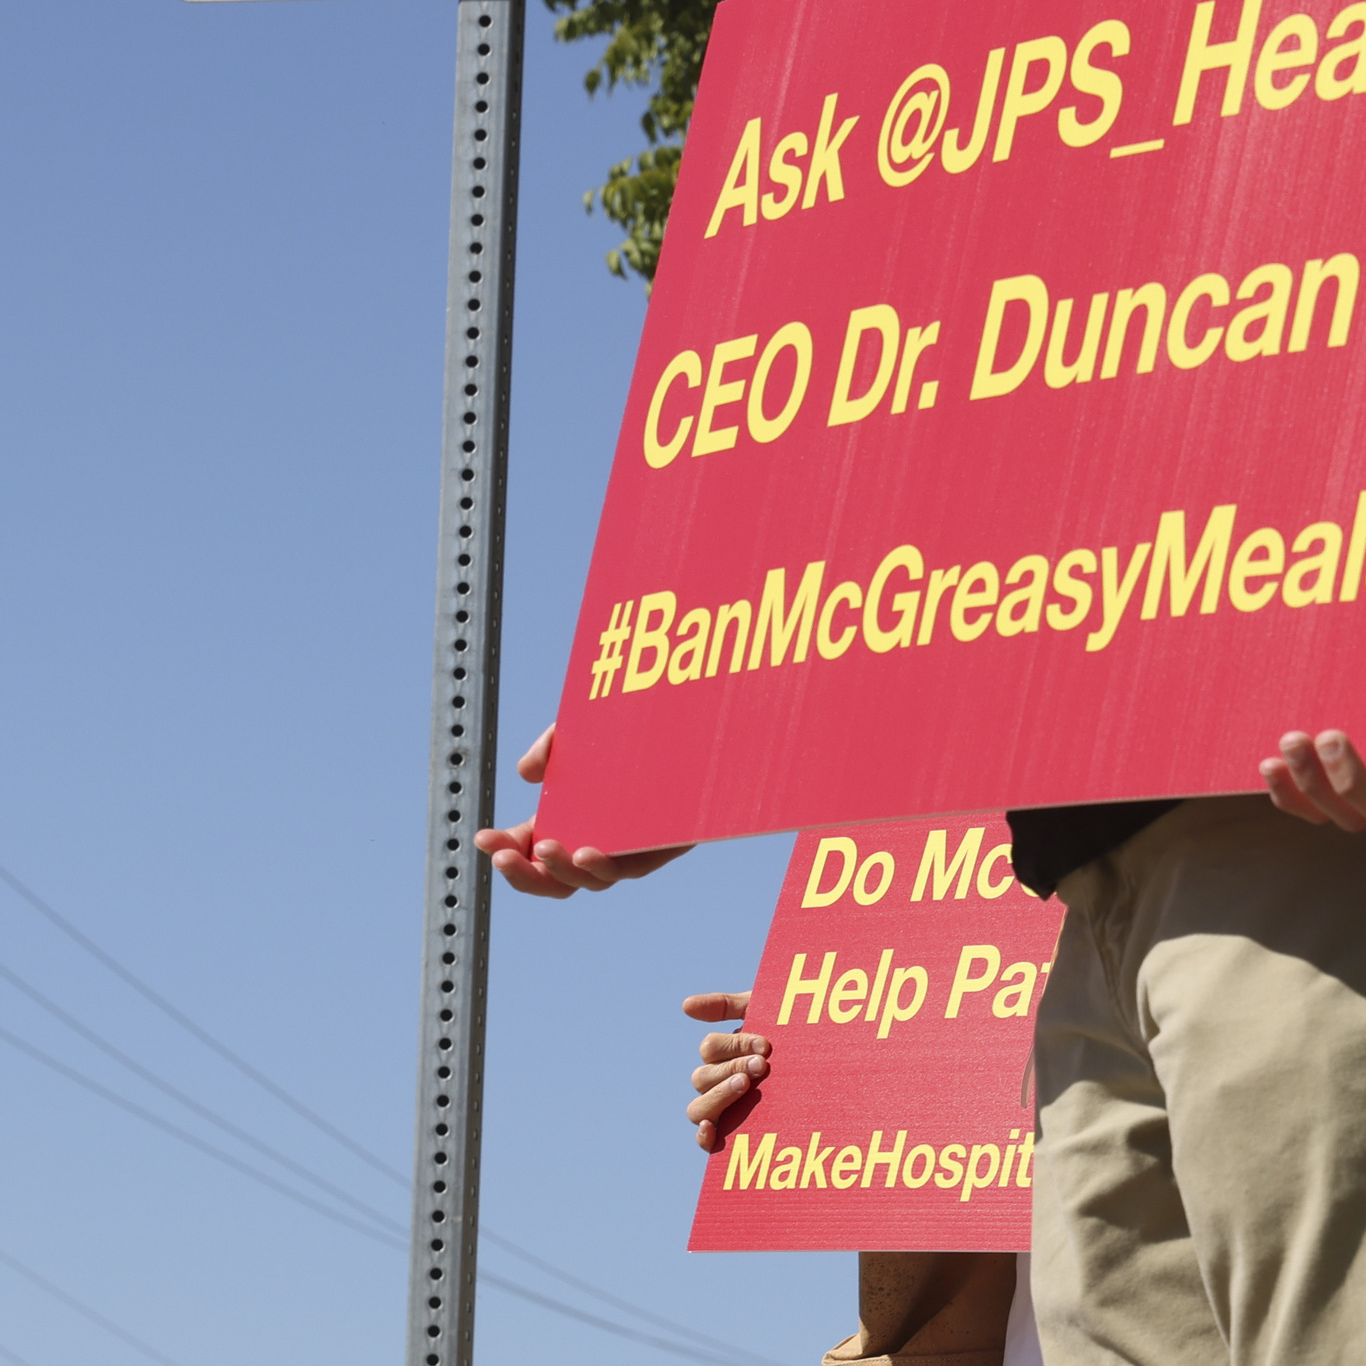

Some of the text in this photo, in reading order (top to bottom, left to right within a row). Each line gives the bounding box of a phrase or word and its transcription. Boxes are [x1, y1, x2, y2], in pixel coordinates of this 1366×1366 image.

[705, 94, 860, 238] Ask
[644, 323, 813, 468] CEO
[828, 305, 940, 426] Dr.
[970, 254, 1359, 400] Duncan
[802, 829, 1041, 907] Do Mc
[778, 950, 928, 1038] Help
